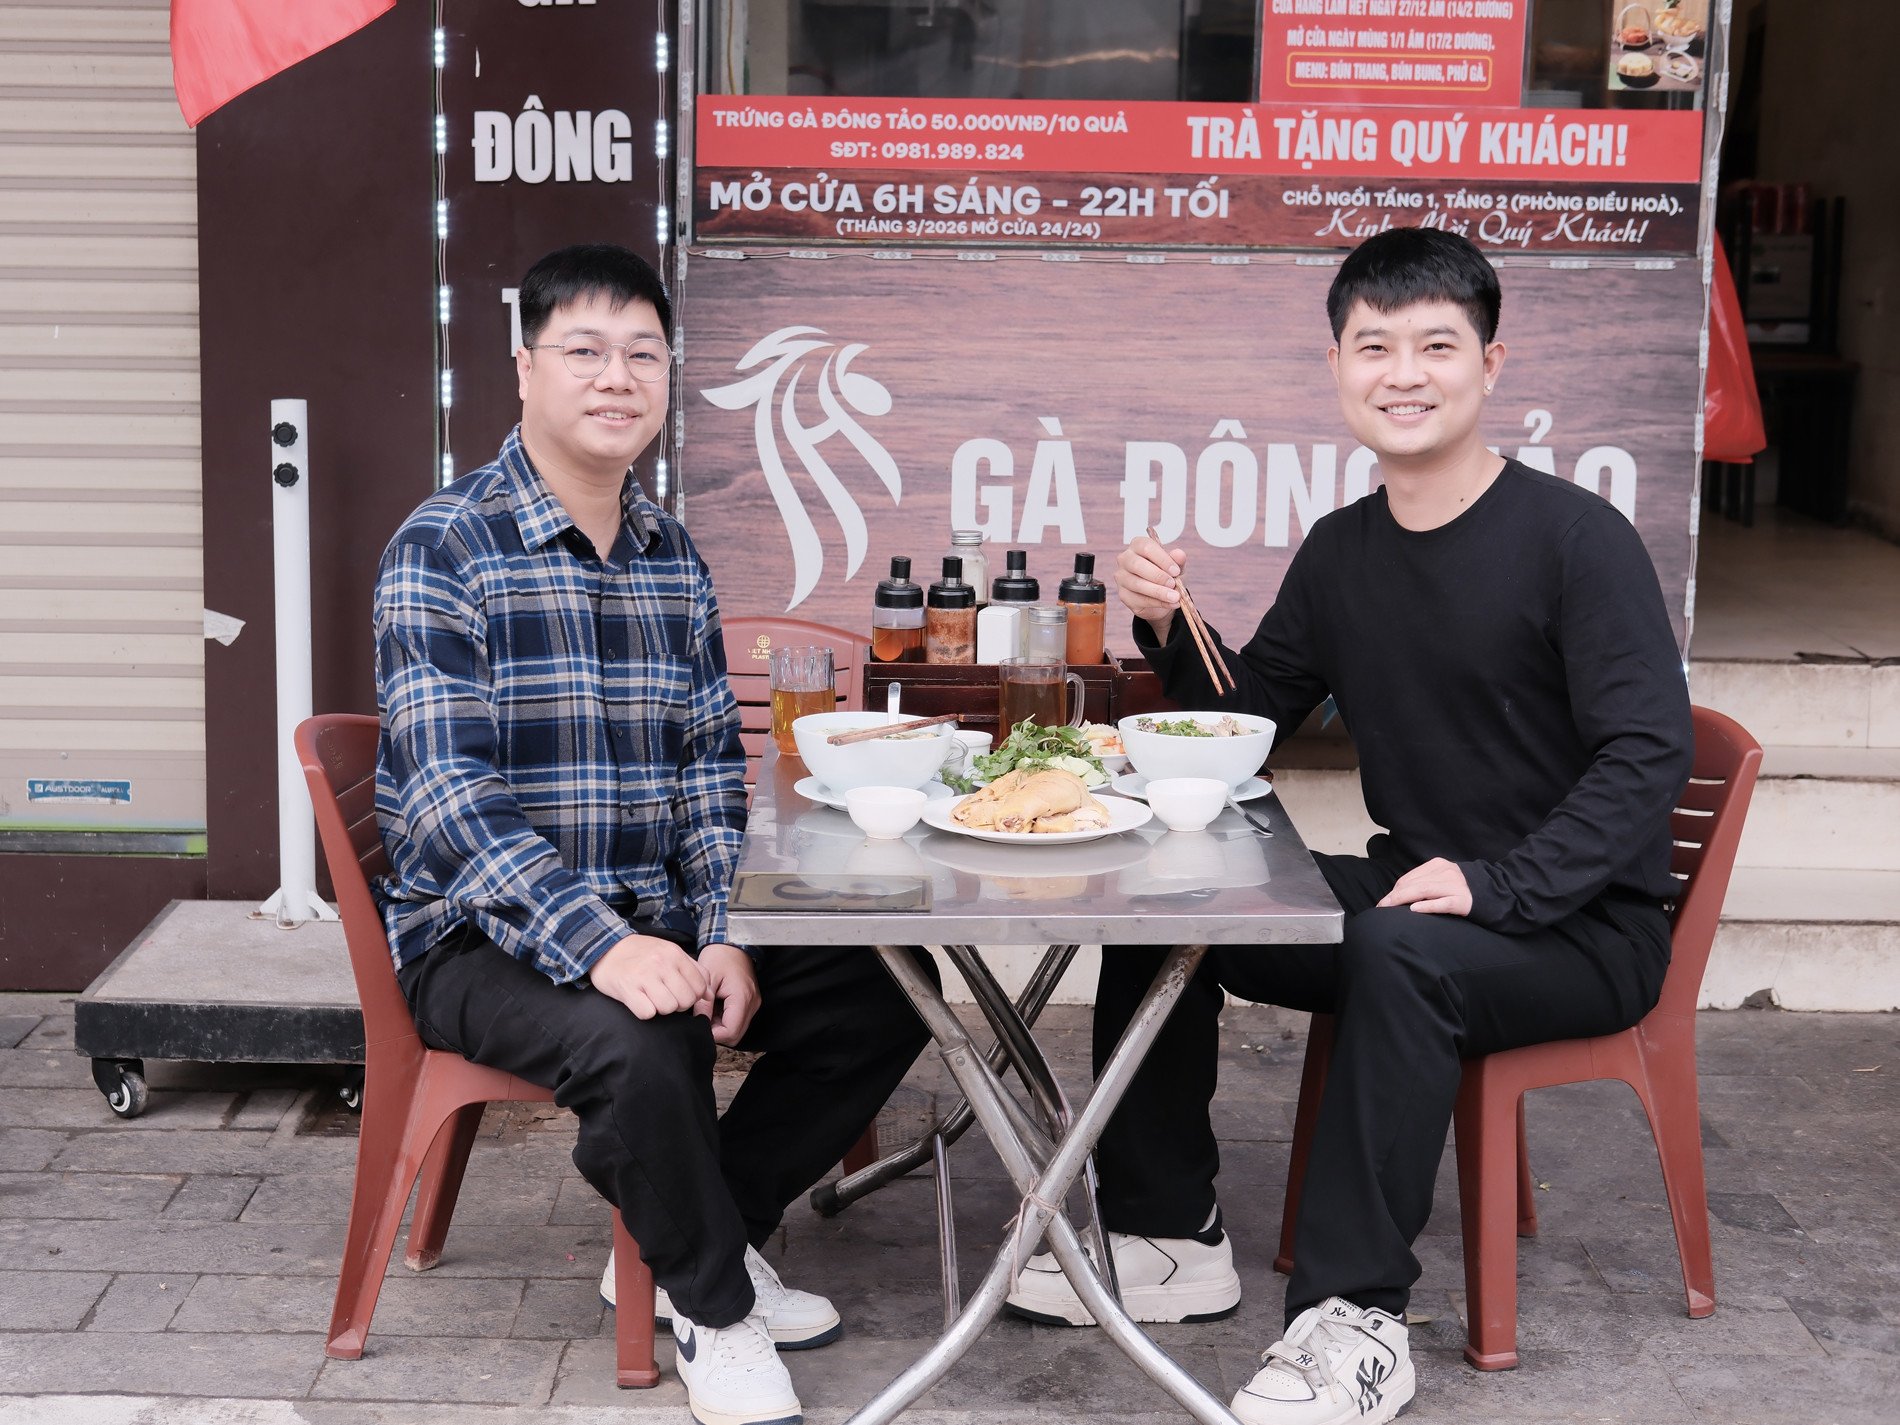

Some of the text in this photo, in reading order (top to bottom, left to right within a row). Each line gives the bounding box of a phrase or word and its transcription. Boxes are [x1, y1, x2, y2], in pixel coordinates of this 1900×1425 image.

[1398, 0, 1426, 16] 27/12
[1287, 24, 1304, 46] MỞ
[1306, 25, 1326, 46] CỬA
[1328, 27, 1356, 47] NGÀY
[1357, 28, 1388, 48] MÙNG
[1390, 32, 1405, 48] 1/1
[1426, 32, 1452, 50] (17/2
[1295, 60, 1486, 83] MENU: BÚN THANG, BÚN BUNG, PHỞ GÀ.
[713, 107, 1128, 135] TRỨNG GÀ ĐÔNG TẢO 50.000VNĐ/10 QUẢ
[472, 94, 633, 184] ĐÔNG
[830, 141, 1024, 160] SĐT: 0981.989.824
[1187, 108, 1628, 169] TRÀ TẶNG QUÝ KHÁCH!
[710, 171, 1229, 218] MỞ CỬA 6H SÁNG - 22H TỐI
[1282, 184, 1684, 216] CHỖ NGỒI TẦNG 1, TẦNG 2 (PHÒNG ĐIỀU HOÀ).
[836, 216, 1102, 240] (THÁNG 3/2026 MỞ CỬA 24/24)
[1314, 208, 1395, 237] Kính
[1478, 210, 1533, 248] Quý
[1541, 212, 1650, 244] Khách!
[950, 416, 1086, 545] GÀ
